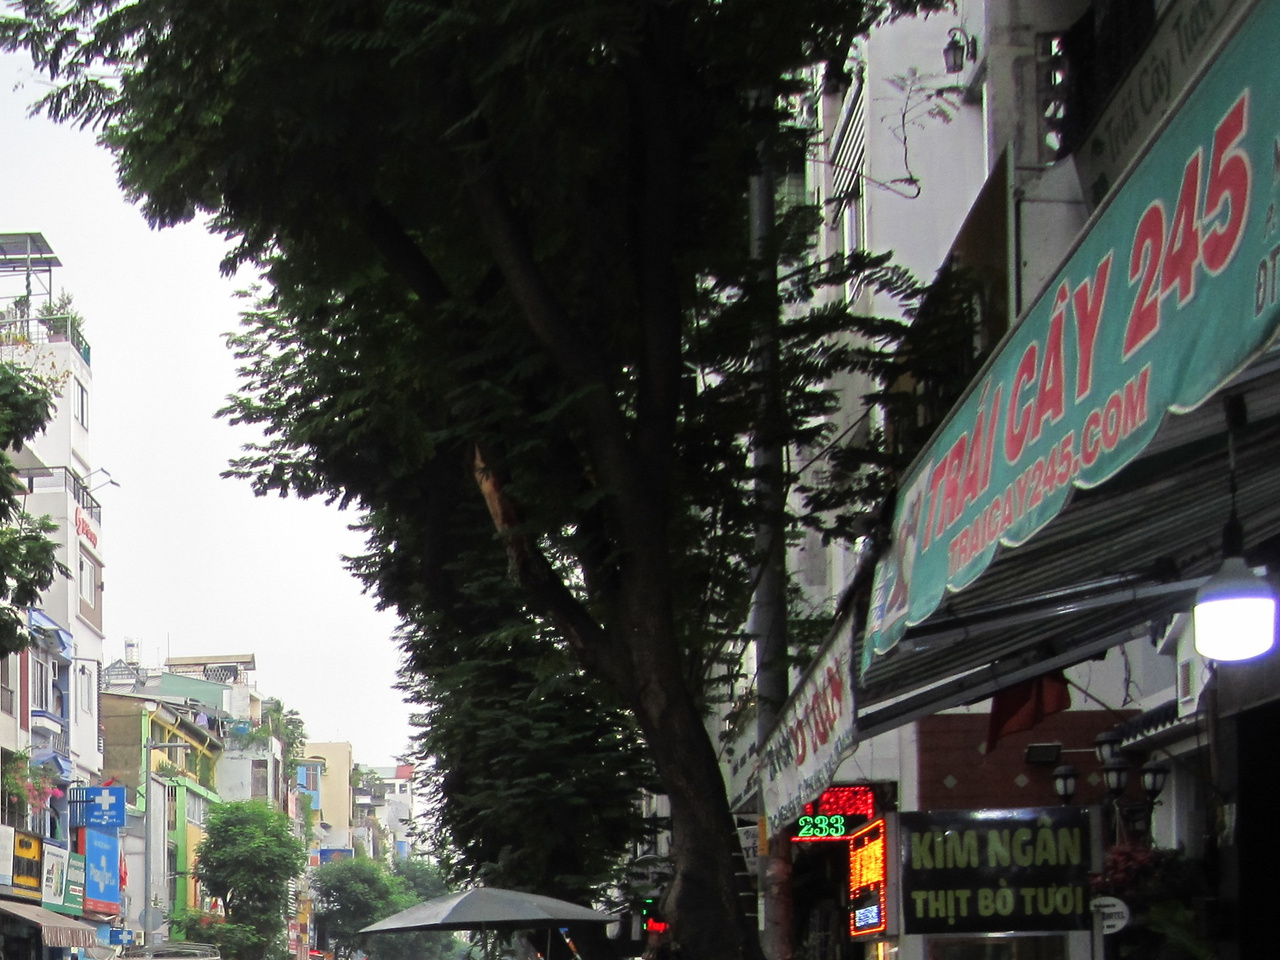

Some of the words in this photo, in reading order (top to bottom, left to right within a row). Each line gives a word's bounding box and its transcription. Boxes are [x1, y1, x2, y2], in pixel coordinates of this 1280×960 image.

[921, 377, 1006, 552] TRÁI
[1004, 249, 1113, 463] CÂY
[1122, 87, 1253, 363] 245
[948, 365, 1151, 577] TRAICAY245.COM
[798, 815, 845, 837] 233
[911, 830, 979, 870] KIM
[987, 812, 1081, 867] NGÂN
[911, 889, 971, 925] THỊT
[978, 878, 1014, 916] BÒ
[1020, 883, 1084, 916] TƯƠI
